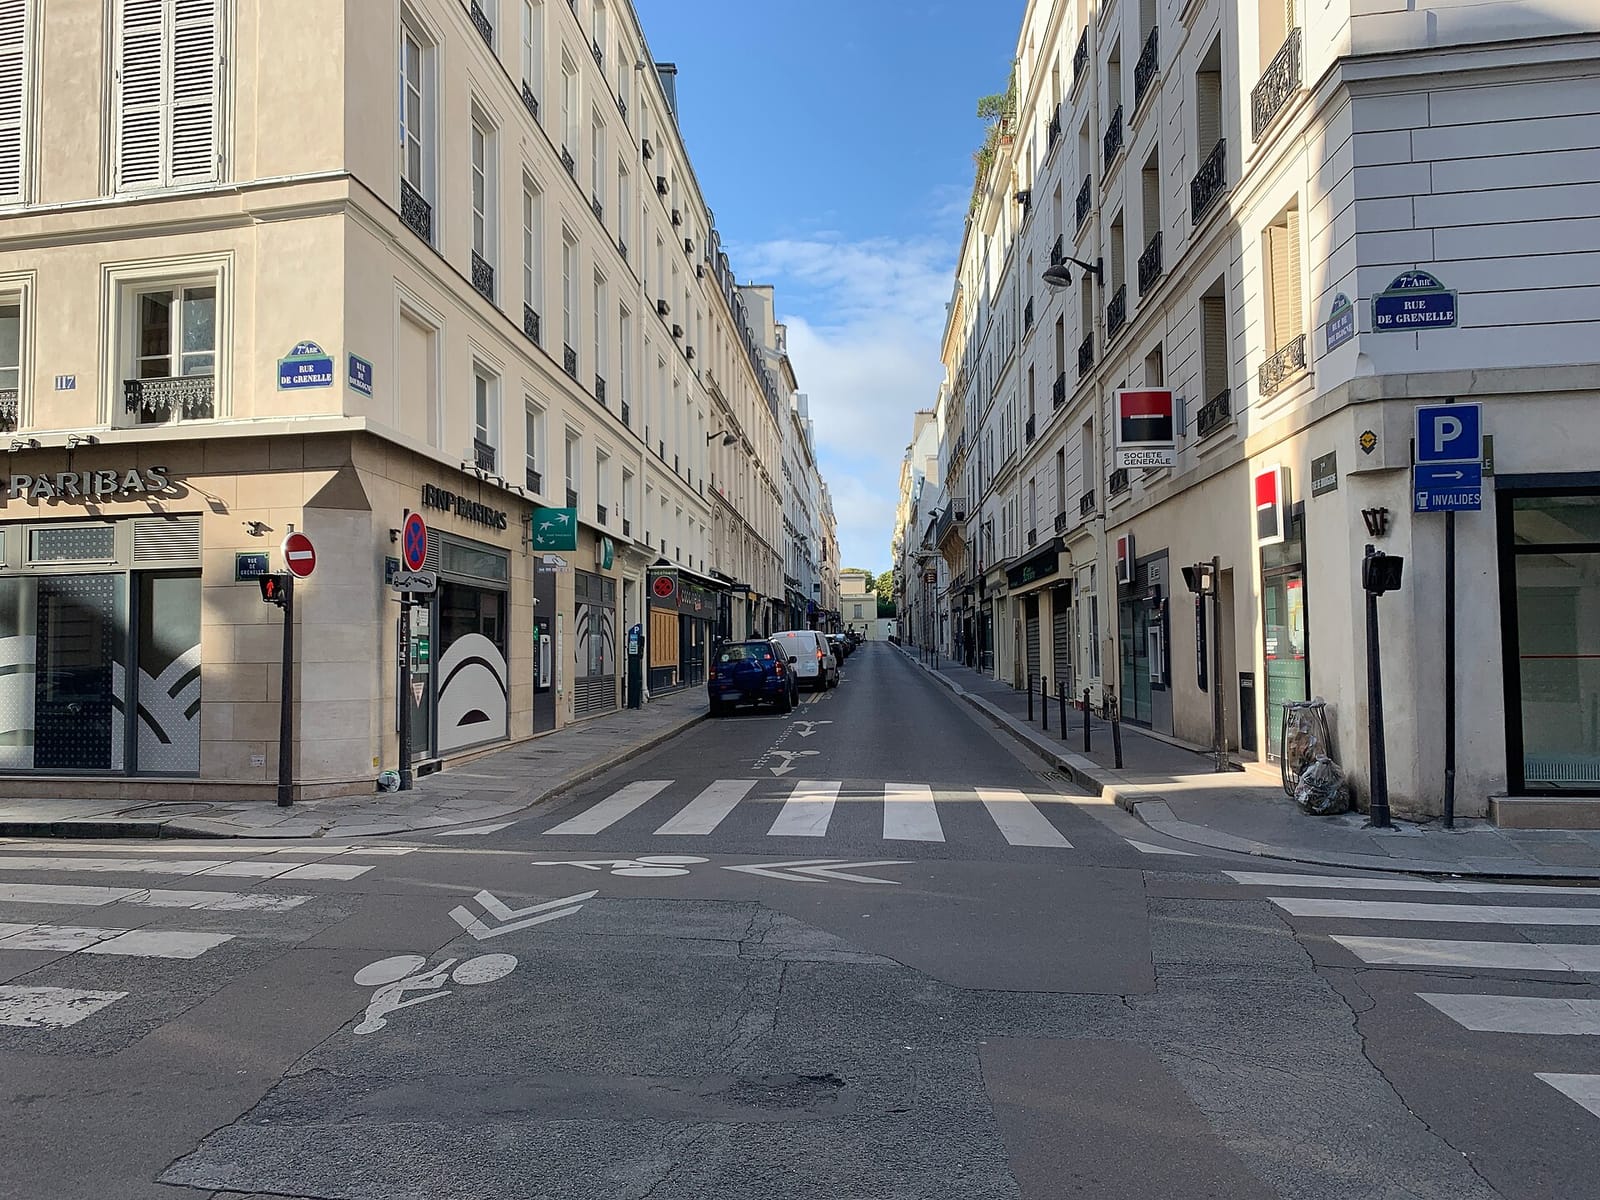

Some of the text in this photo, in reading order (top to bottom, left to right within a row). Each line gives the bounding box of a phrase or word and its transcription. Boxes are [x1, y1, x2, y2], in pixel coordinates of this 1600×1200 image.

[1404, 300, 1426, 310] RUE
[1377, 311, 1454, 324] DE GRENELLE
[299, 364, 314, 374] RUE
[57, 376, 75, 389] 117
[281, 373, 332, 385] DE GRENELLE
[1434, 416, 1462, 452] P
[10, 466, 169, 498] PARIBAS
[1432, 493, 1481, 506] INVALIDES
[422, 483, 508, 530] BNP PARIBAS
